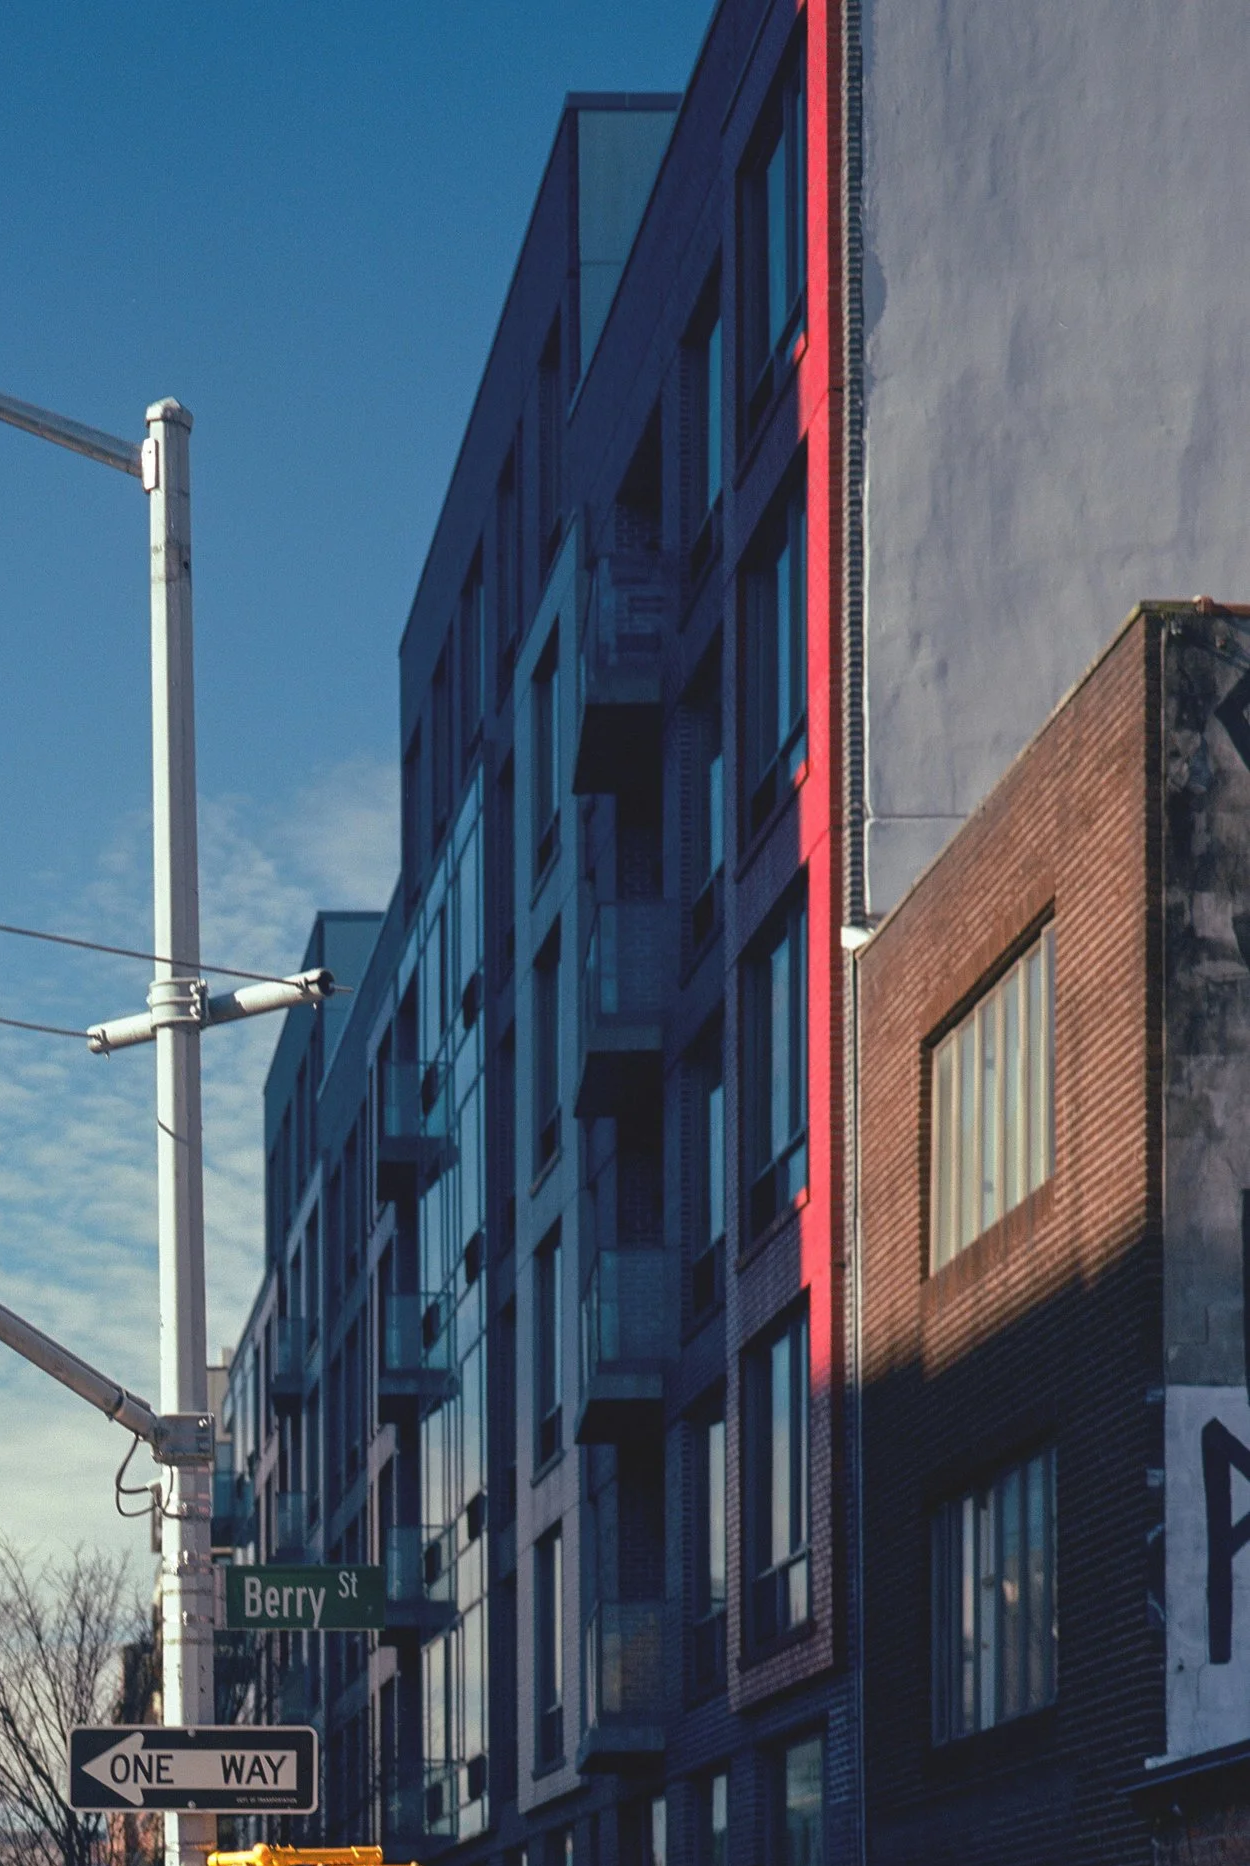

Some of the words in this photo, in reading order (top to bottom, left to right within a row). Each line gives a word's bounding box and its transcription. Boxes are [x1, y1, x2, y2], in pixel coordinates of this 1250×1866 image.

[244, 1575, 326, 1629] Berry
[338, 1570, 359, 1598] St
[110, 1754, 175, 1784] ONE
[220, 1754, 287, 1785] WAY
